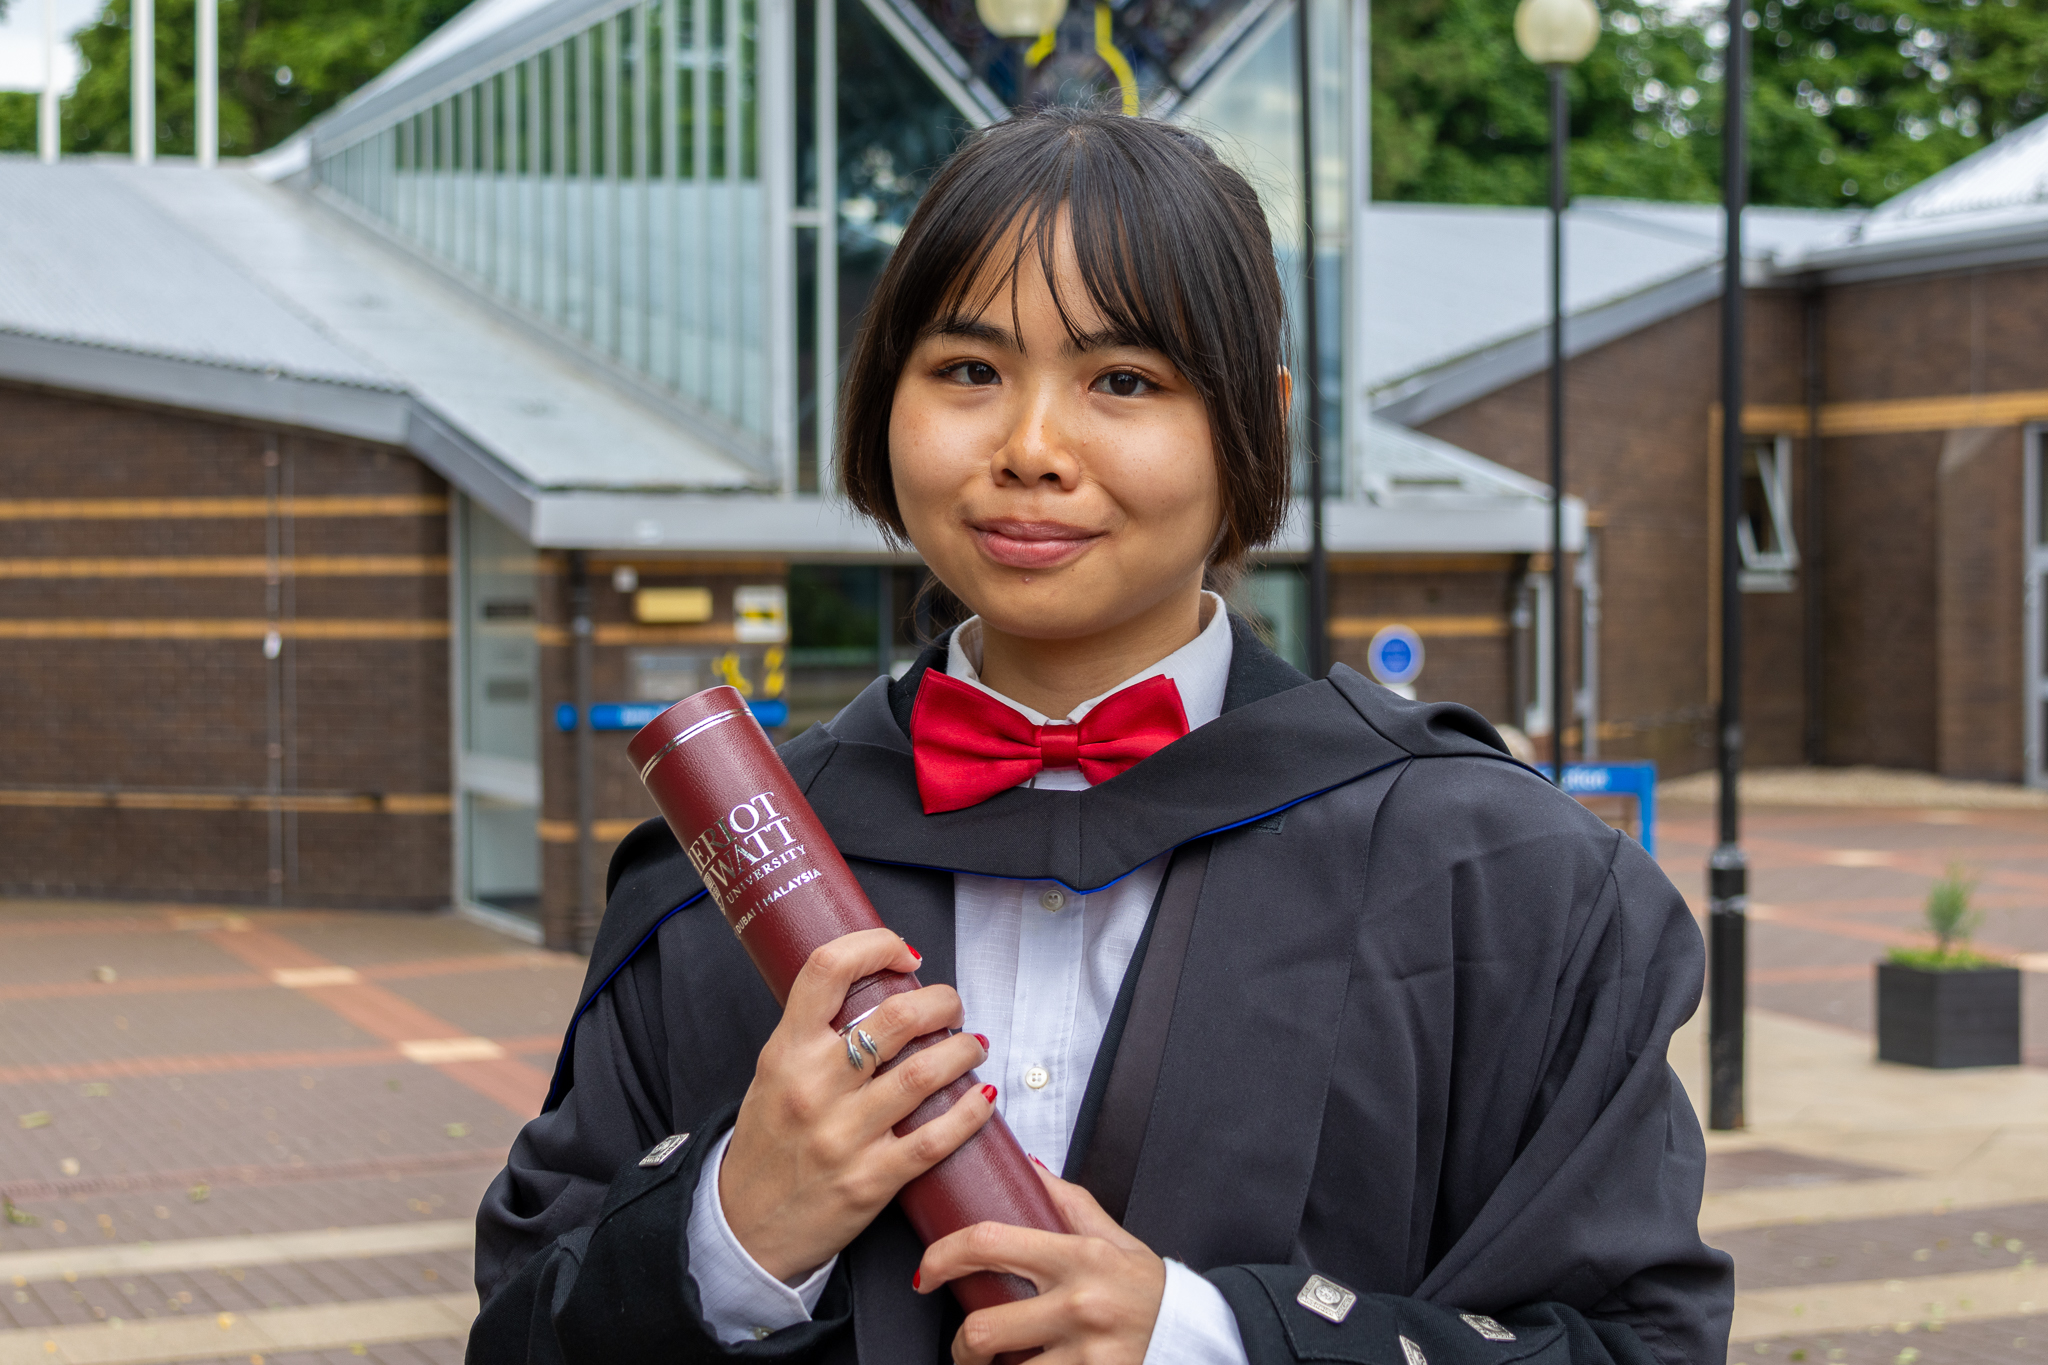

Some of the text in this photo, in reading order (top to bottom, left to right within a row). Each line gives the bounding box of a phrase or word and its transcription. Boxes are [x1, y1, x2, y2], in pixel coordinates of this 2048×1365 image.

[709, 816, 797, 887] WATT
[726, 844, 806, 904] UNIVERSITY
[735, 868, 822, 934] DUBAI MALAYSIA
